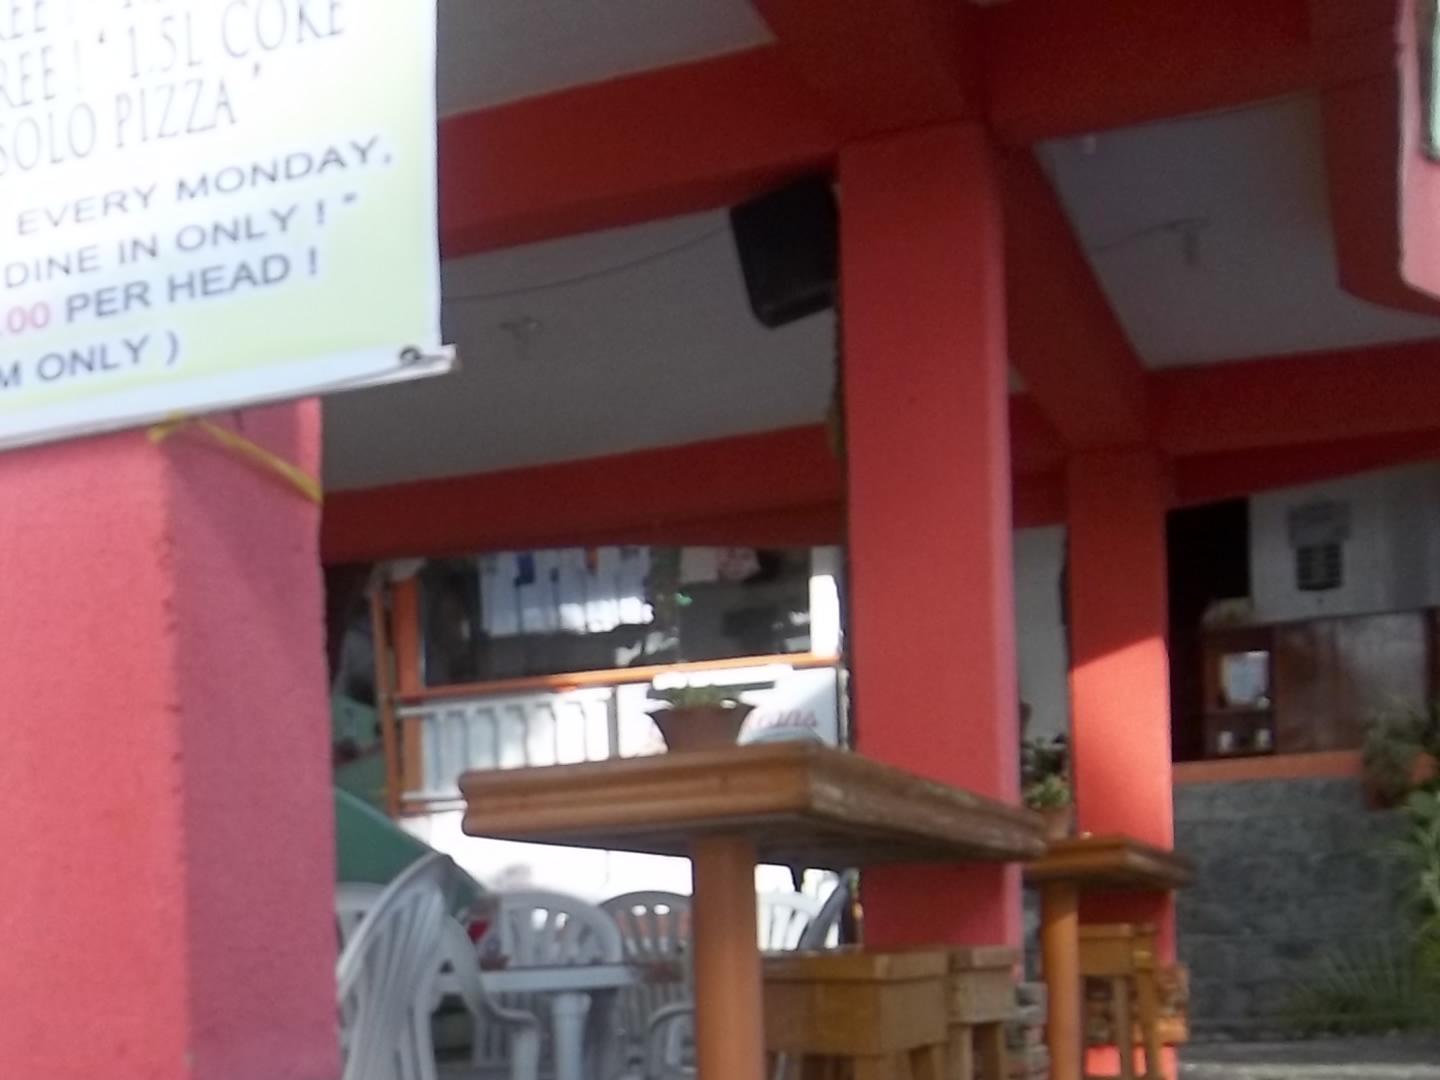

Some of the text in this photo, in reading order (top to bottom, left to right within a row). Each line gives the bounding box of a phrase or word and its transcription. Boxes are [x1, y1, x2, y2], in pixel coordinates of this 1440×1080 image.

[221, 0, 344, 58] COKE
[17, 183, 158, 236] EVERY
[4, 244, 102, 289] DINE
[117, 234, 160, 266] IN
[65, 280, 152, 325] PER
